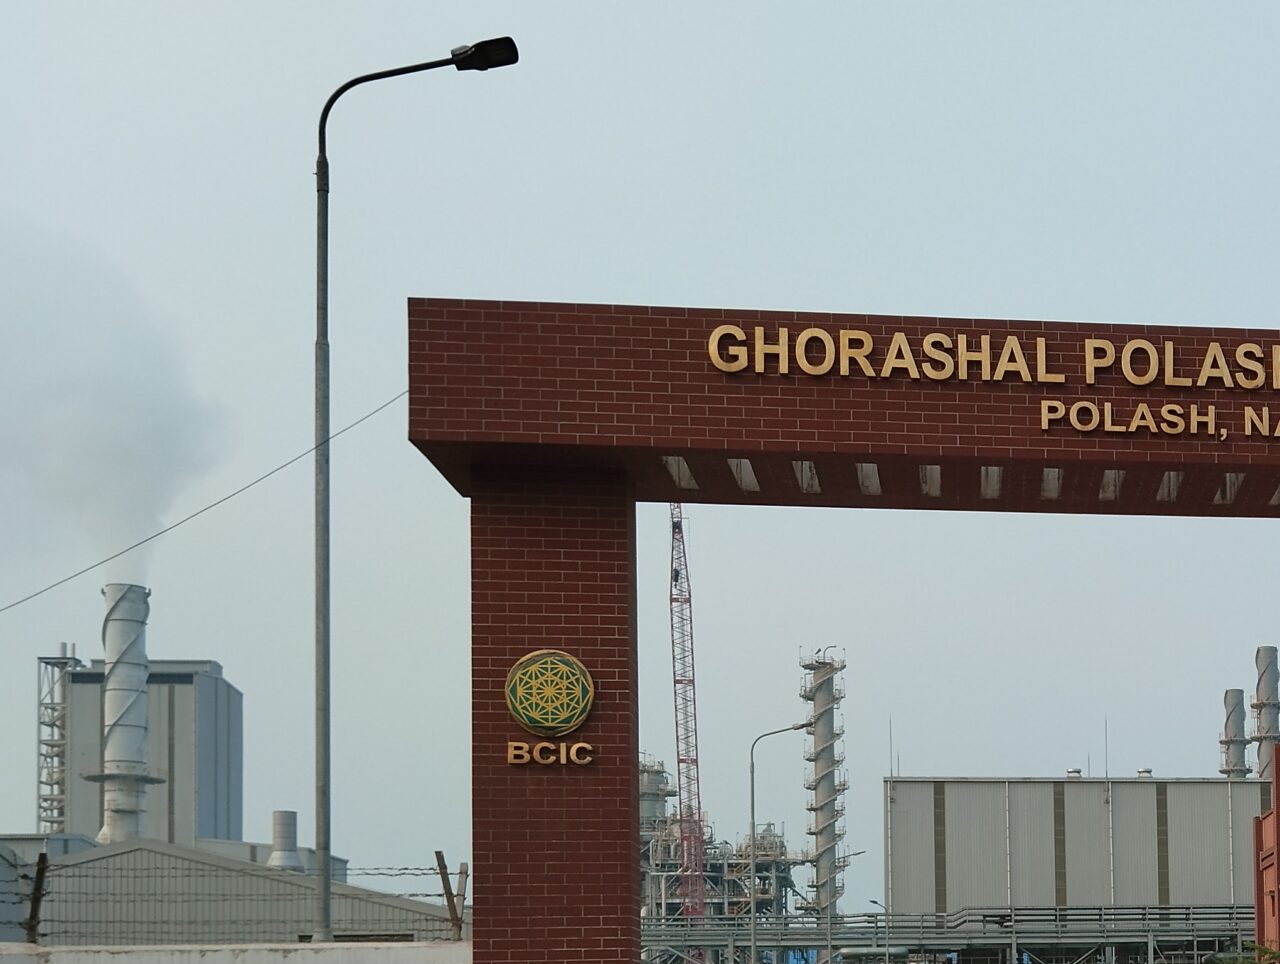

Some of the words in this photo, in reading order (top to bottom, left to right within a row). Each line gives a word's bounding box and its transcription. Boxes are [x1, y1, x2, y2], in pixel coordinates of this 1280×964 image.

[708, 325, 1066, 384] GHORASHAL
[1040, 399, 1229, 442] POLASH,
[507, 741, 594, 765] BCIC
